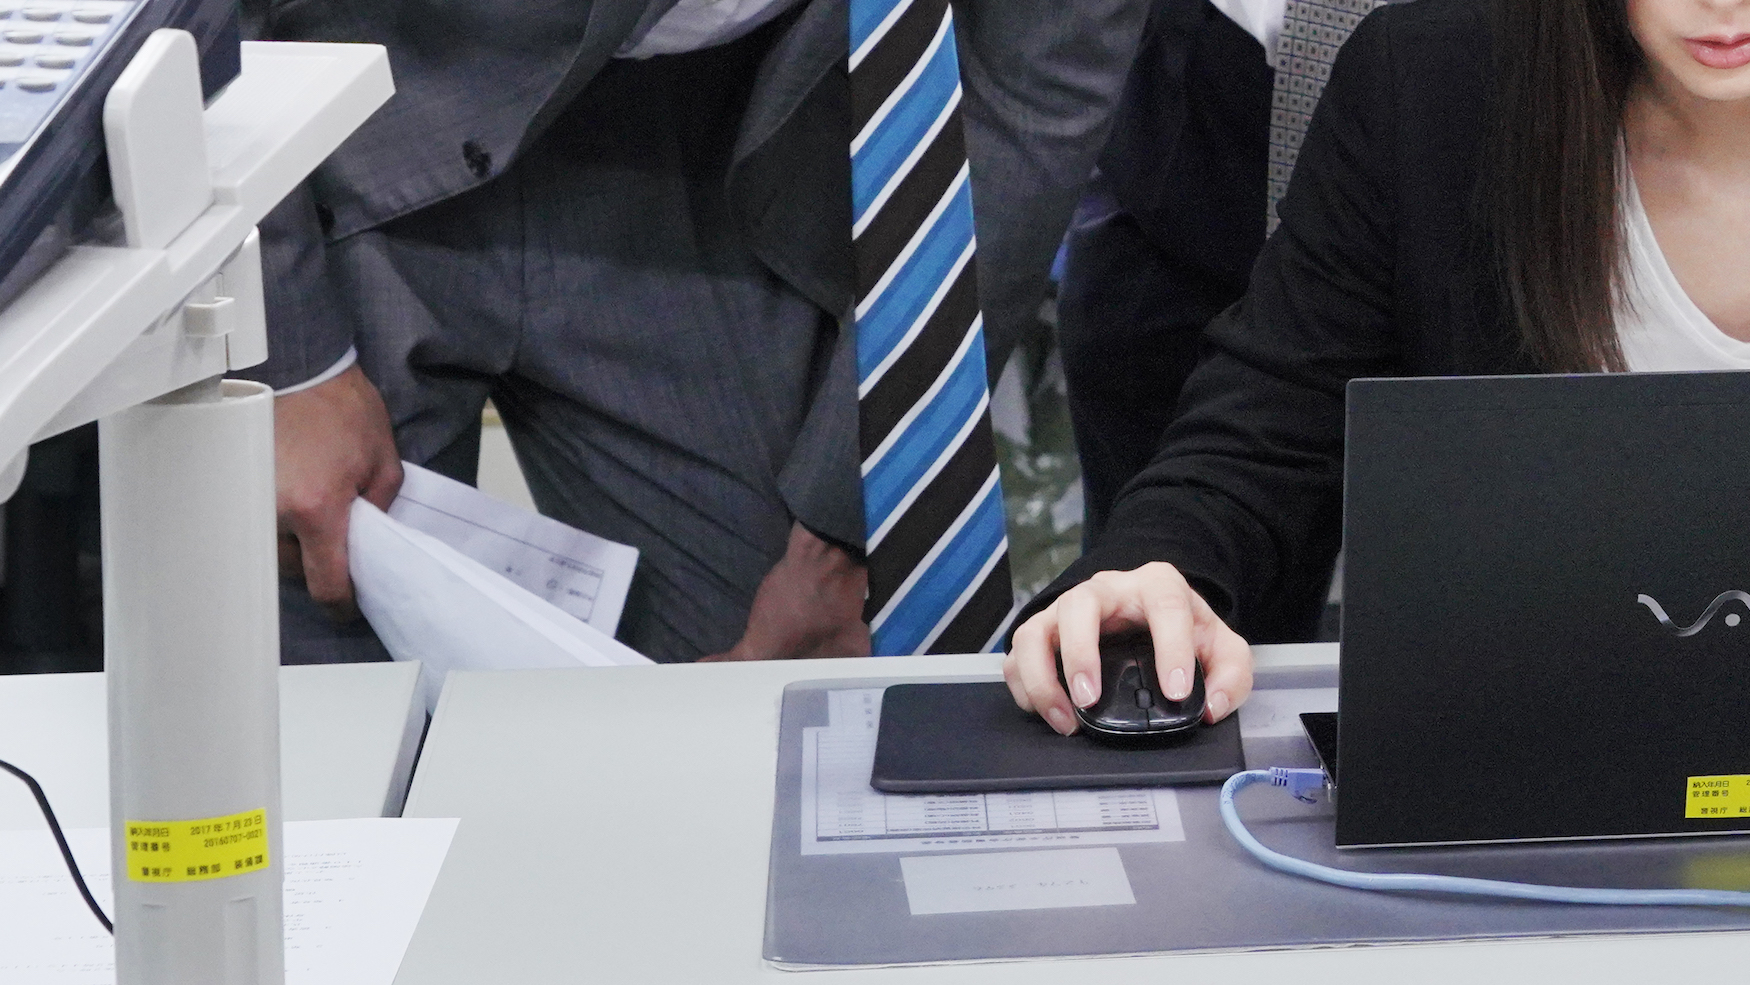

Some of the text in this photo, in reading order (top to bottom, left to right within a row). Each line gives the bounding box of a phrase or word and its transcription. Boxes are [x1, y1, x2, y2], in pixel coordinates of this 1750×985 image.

[1692, 789, 1729, 798] 管理番号
[1701, 806, 1728, 815] 警視庁
